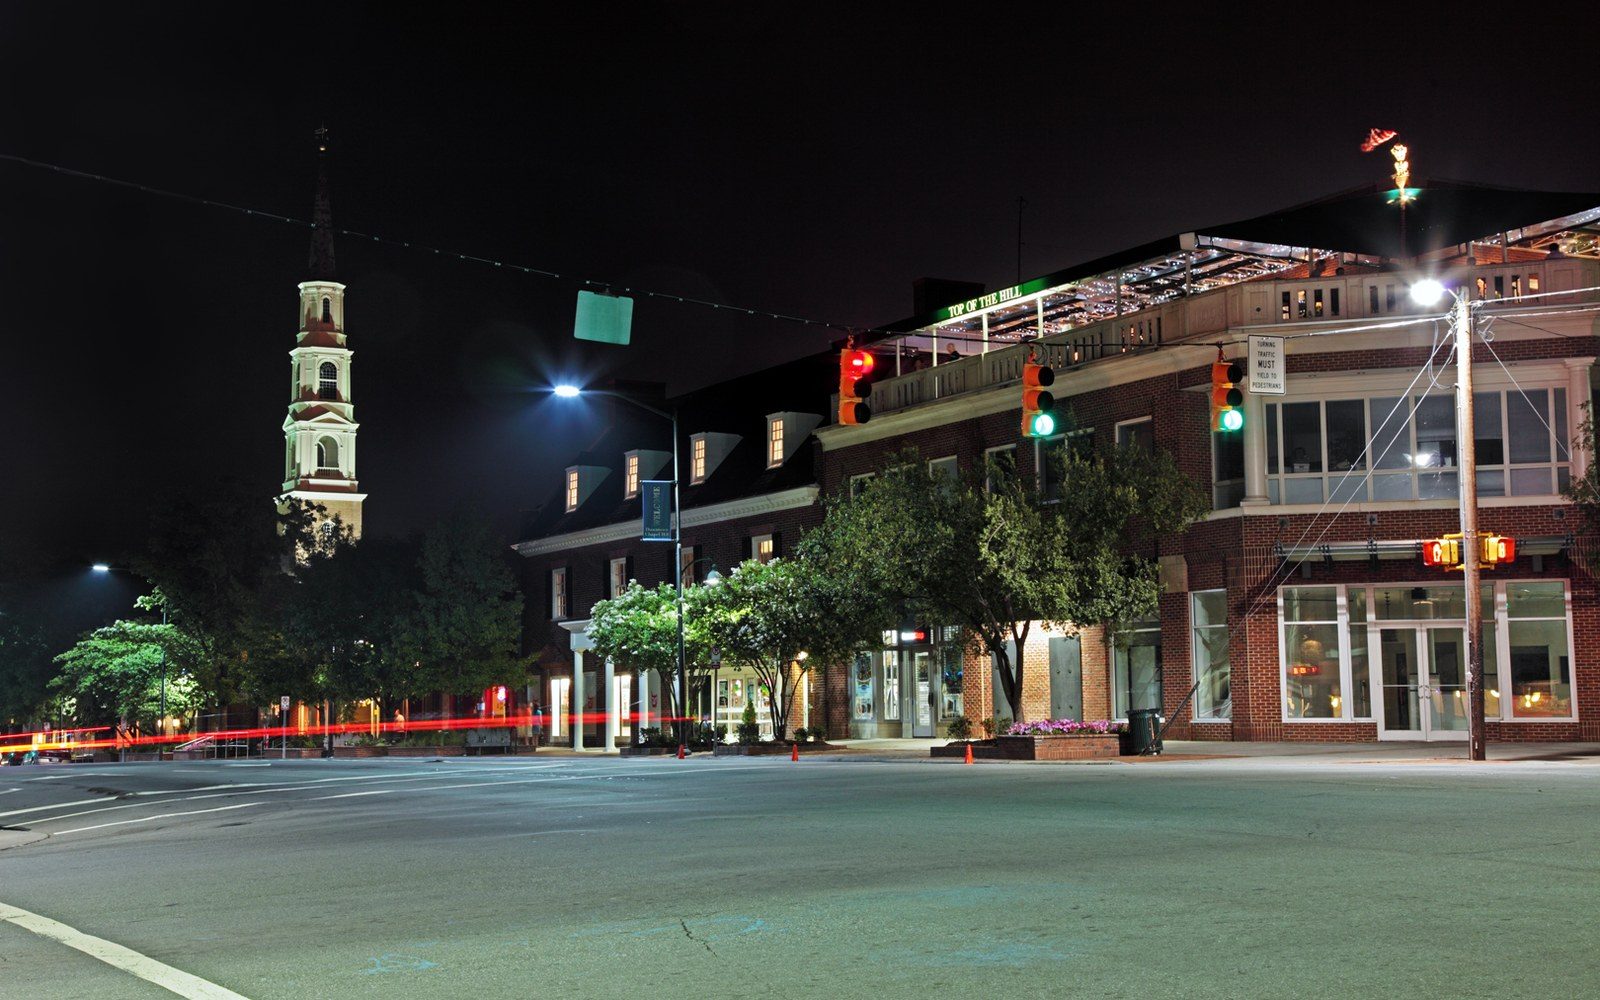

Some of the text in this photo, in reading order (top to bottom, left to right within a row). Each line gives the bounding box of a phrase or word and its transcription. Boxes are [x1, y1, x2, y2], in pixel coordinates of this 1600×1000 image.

[948, 286, 1022, 318] TOP OF THE HILL
[1258, 360, 1275, 368] MUST
